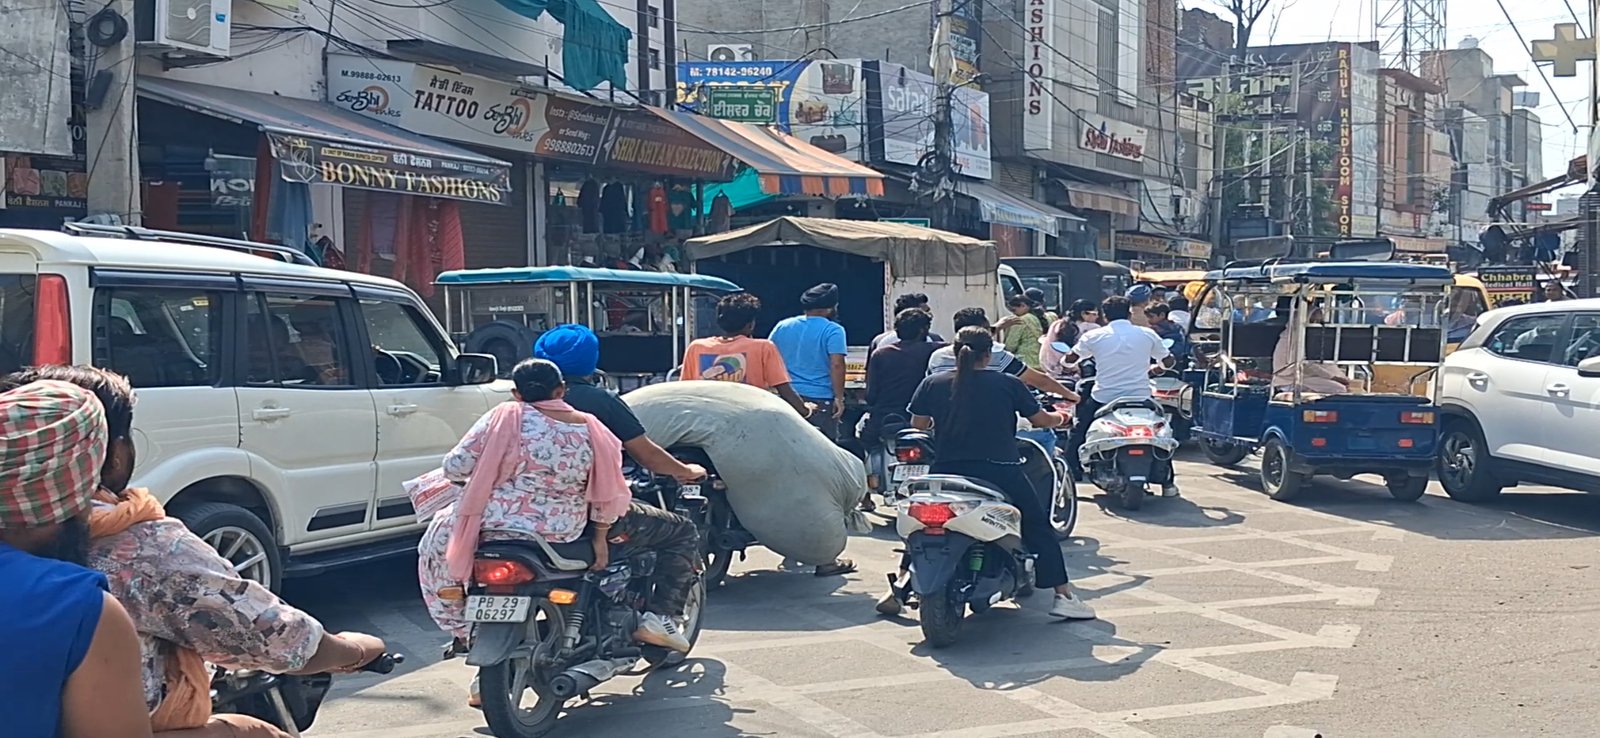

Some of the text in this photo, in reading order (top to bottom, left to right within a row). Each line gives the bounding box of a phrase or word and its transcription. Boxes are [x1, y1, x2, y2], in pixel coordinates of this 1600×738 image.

[706, 67, 773, 77] 78142-96240
[1339, 50, 1348, 98] RAHUL
[414, 89, 479, 119] TATTOO
[543, 138, 595, 157] 9988802613
[611, 136, 641, 162] SHRI
[672, 145, 724, 173] SELECTION
[320, 161, 500, 202] BONNY FASHIONS
[1339, 195, 1350, 237] STOR
[1481, 273, 1533, 282] Chhabra
[478, 597, 519, 608] PB 29
